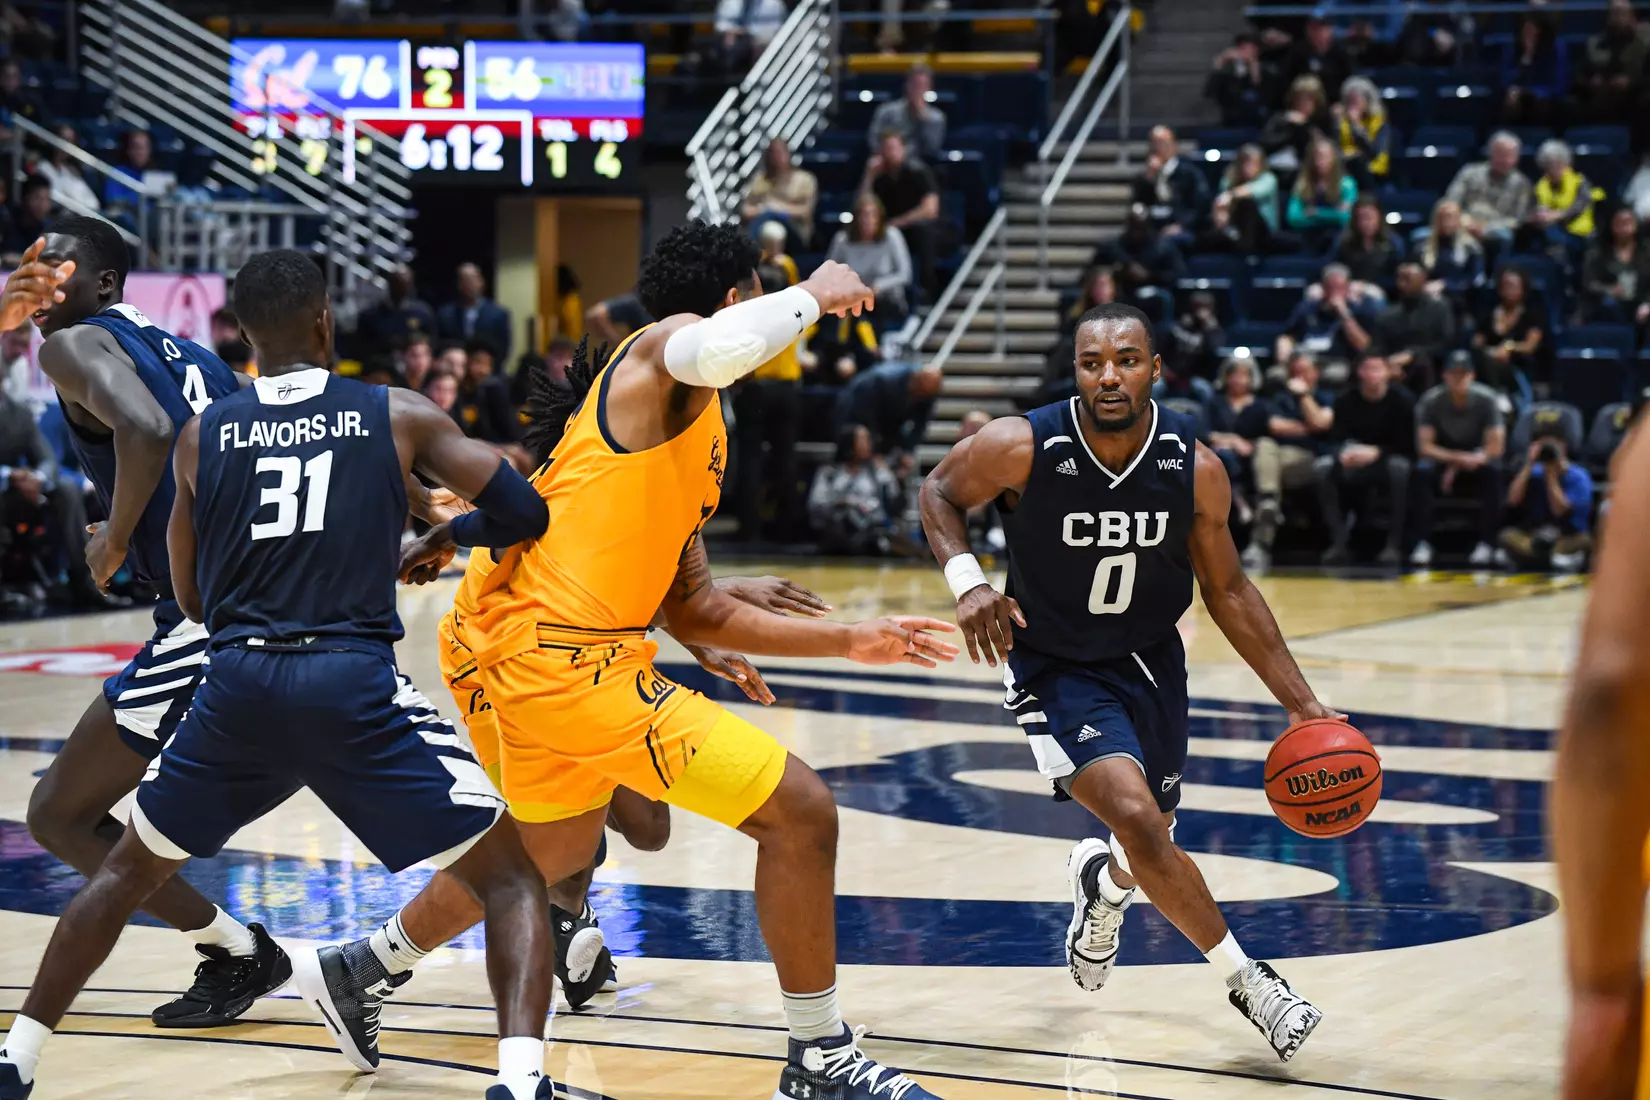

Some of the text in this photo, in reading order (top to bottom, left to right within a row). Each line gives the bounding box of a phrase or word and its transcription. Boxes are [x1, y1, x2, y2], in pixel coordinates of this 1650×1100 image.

[332, 54, 392, 100] 76
[423, 68, 453, 108] 2
[484, 57, 542, 101] 56
[400, 123, 504, 171] 6:12
[546, 141, 567, 179] 1
[594, 142, 622, 179] 4
[182, 364, 213, 415] 4
[220, 411, 369, 451] FLAVORS JR.
[1055, 465, 1078, 476] adidas
[1157, 459, 1183, 470] WAC
[251, 450, 333, 540] 31
[1062, 511, 1169, 548] CBU
[1088, 552, 1137, 614] 0
[636, 667, 675, 709] Cal
[1077, 731, 1101, 742] adidas
[1285, 765, 1366, 797] Wilson
[1305, 801, 1362, 825] NCAA
